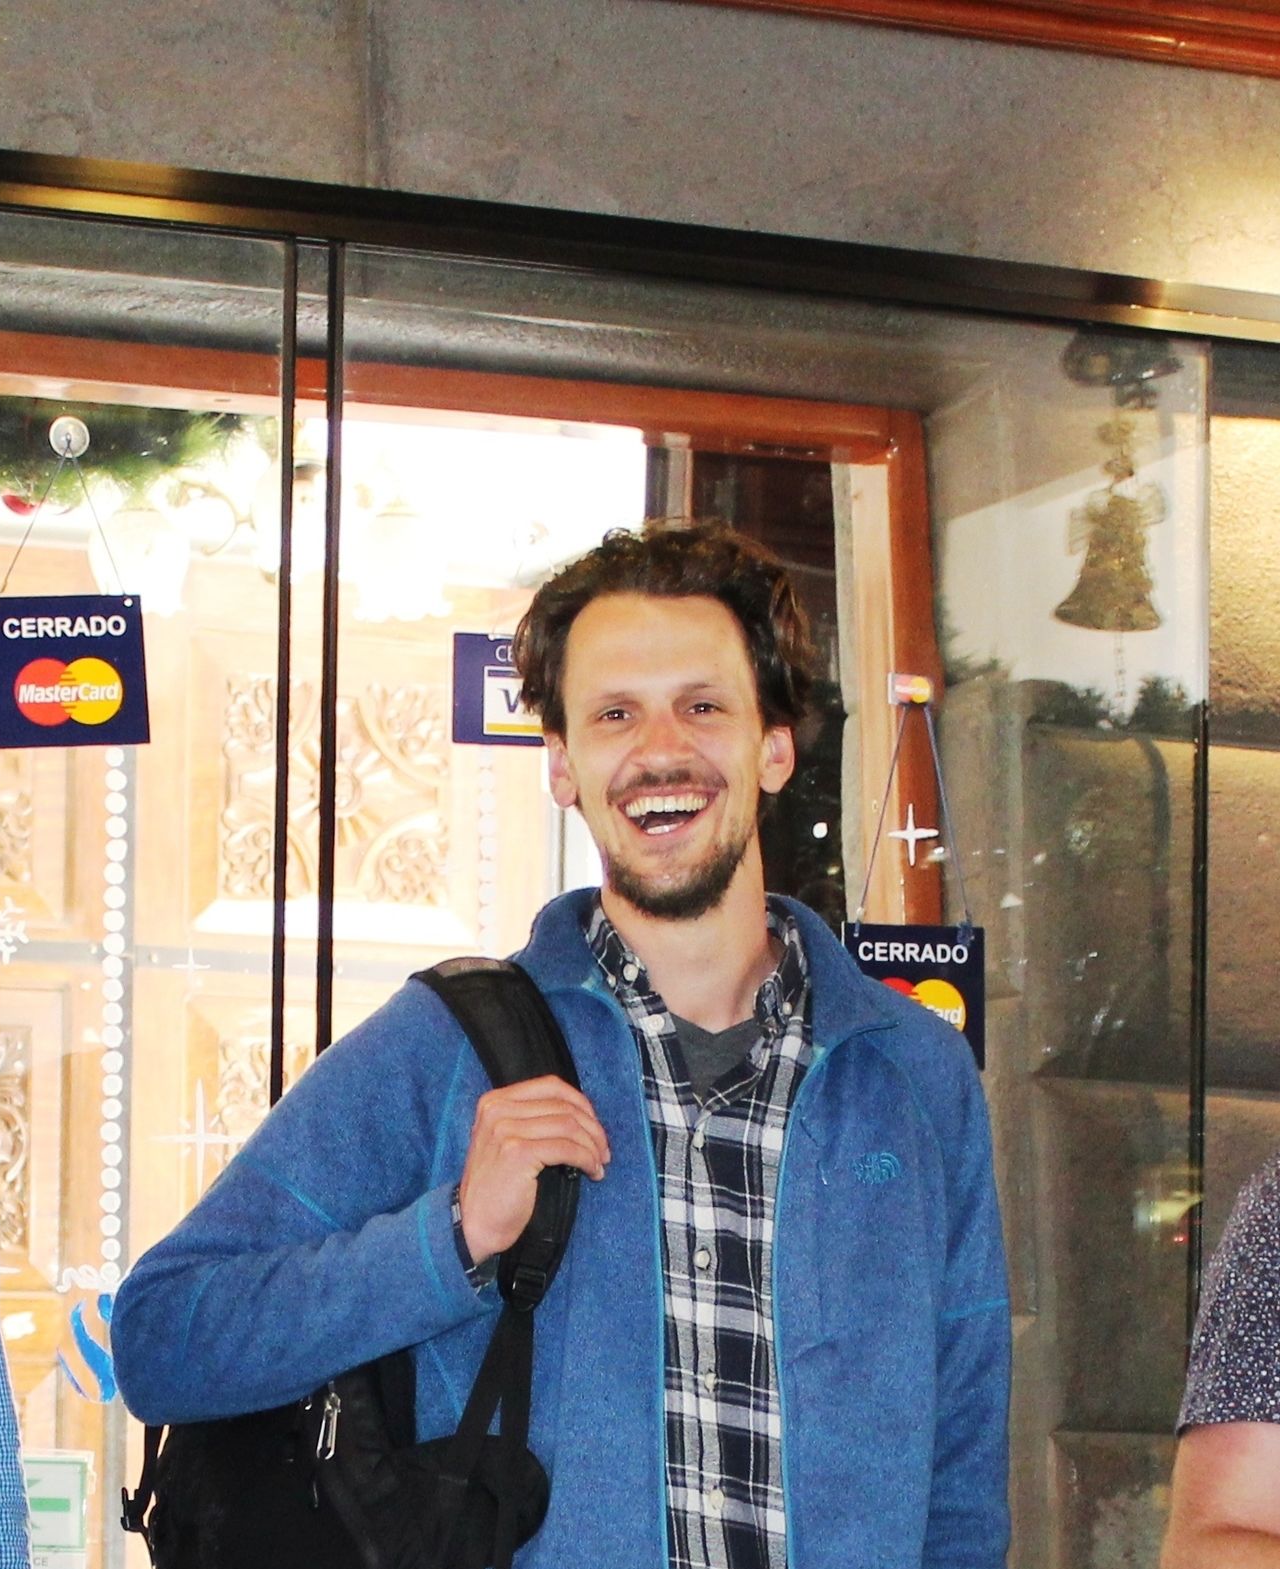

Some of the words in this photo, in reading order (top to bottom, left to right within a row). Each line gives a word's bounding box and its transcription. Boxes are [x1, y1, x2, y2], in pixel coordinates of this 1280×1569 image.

[2, 614, 127, 639] CERRADO
[18, 681, 120, 704] MasterCard
[858, 941, 969, 964] CERRADO
